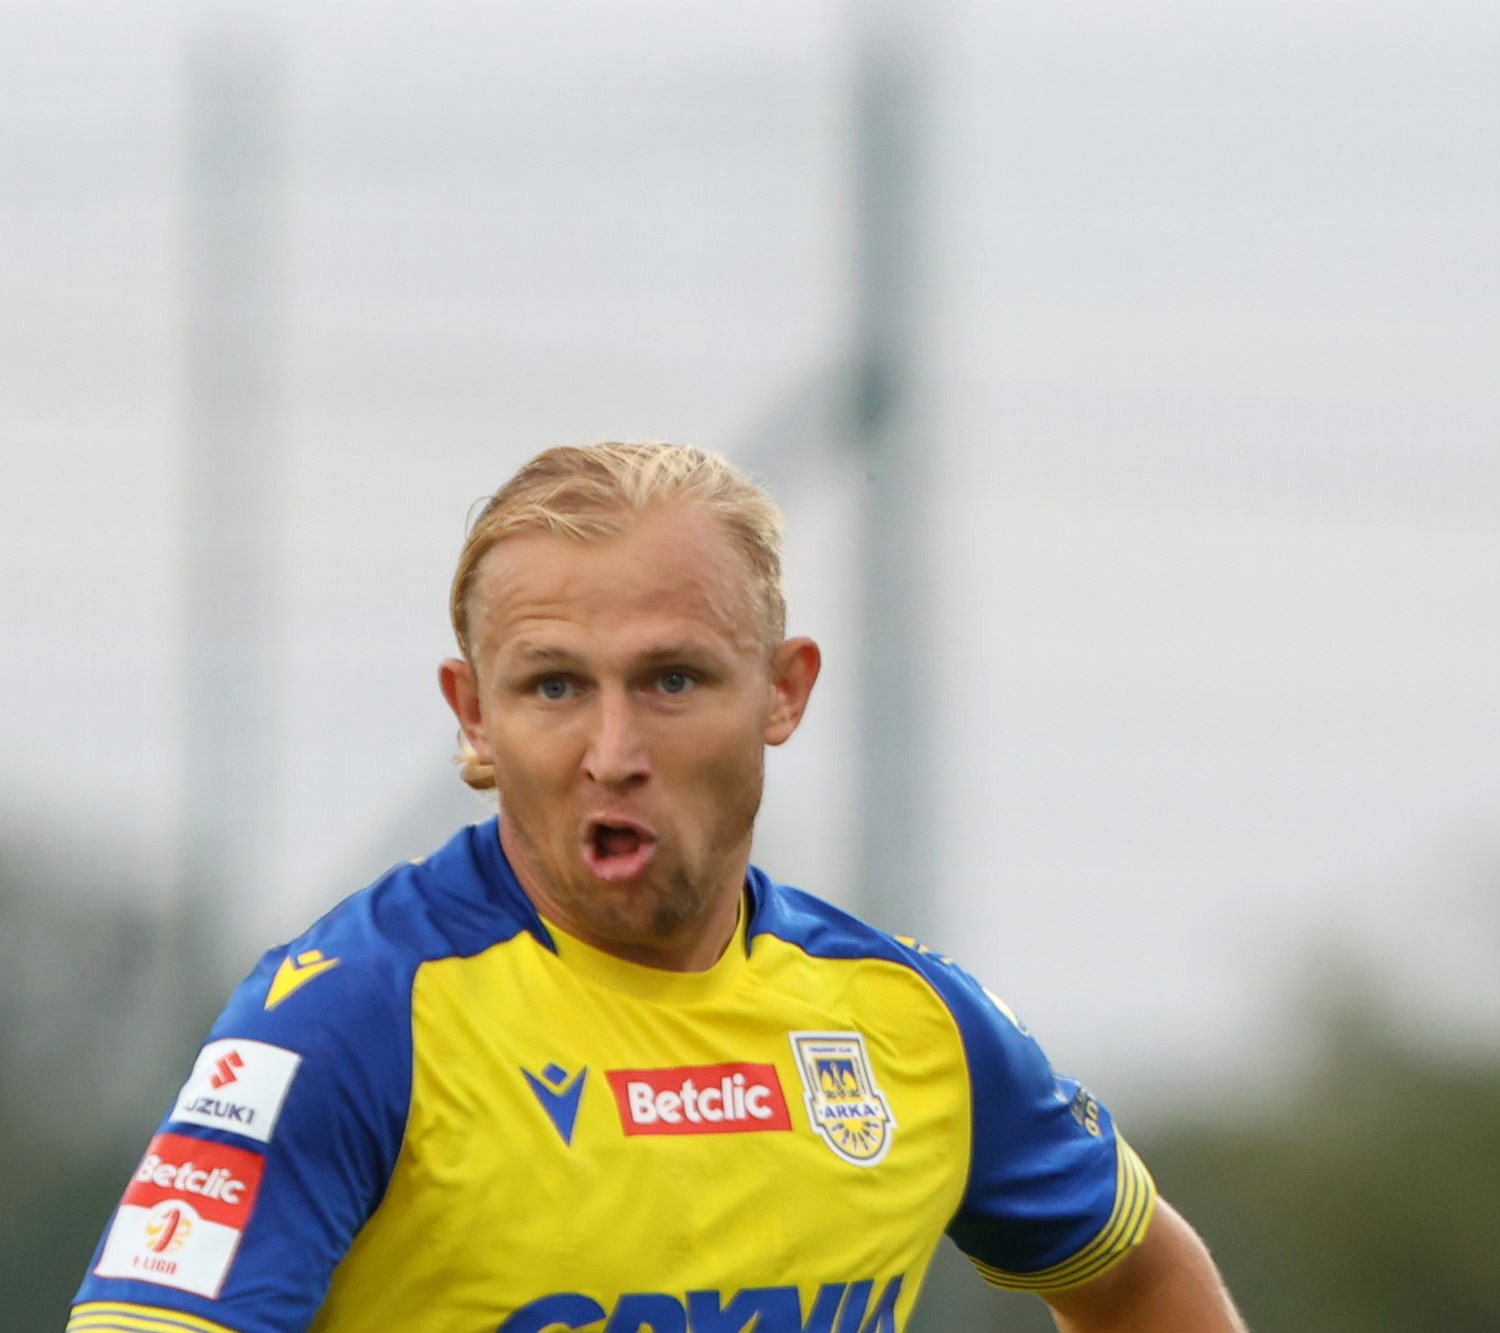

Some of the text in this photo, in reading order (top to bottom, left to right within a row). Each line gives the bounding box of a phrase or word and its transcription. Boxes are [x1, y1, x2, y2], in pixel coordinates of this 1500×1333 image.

[628, 1072, 774, 1125] Betclic
[824, 1104, 876, 1119] ARKA
[135, 1154, 247, 1205] Betclic
